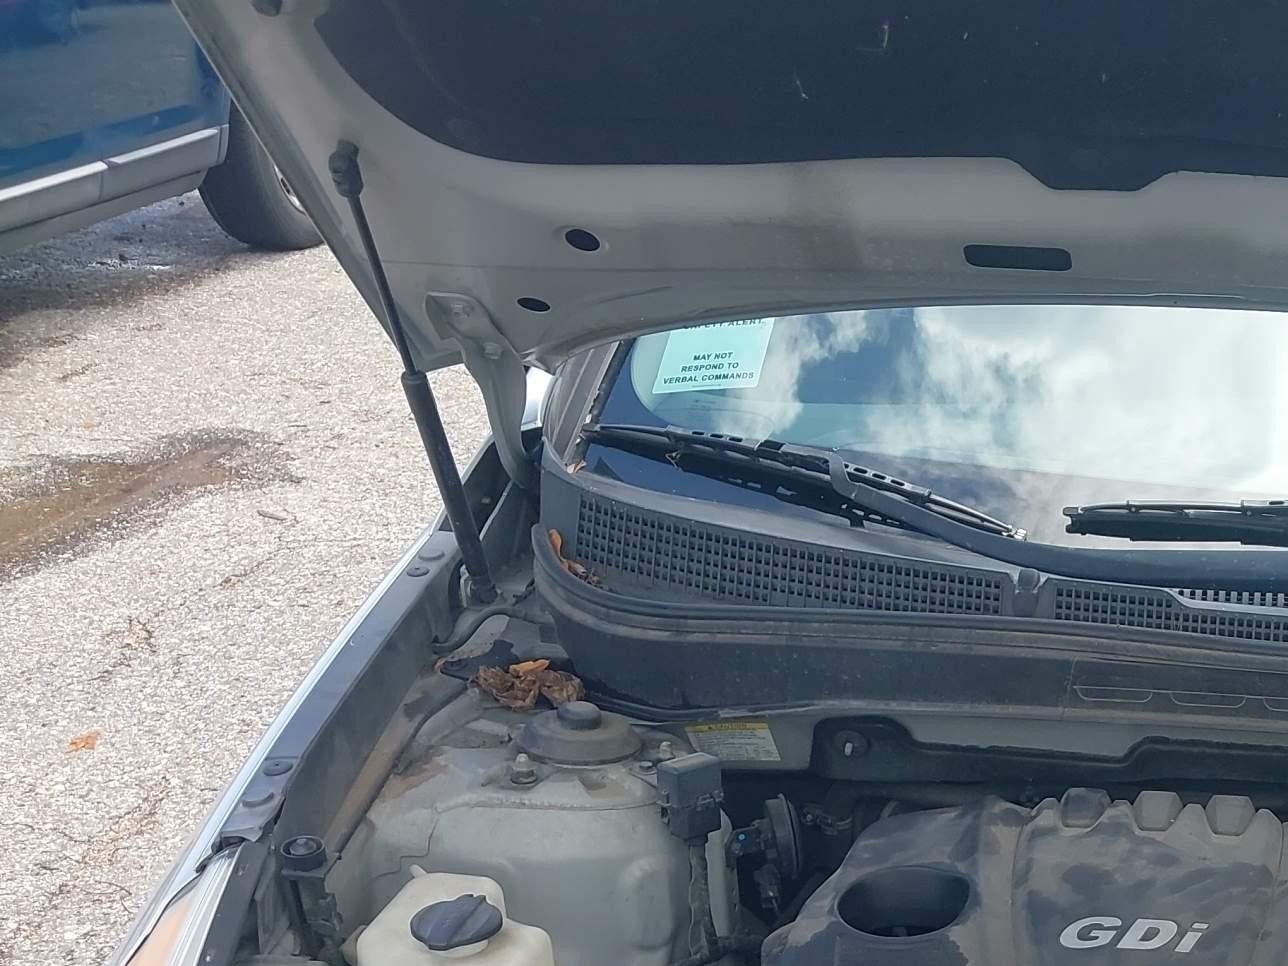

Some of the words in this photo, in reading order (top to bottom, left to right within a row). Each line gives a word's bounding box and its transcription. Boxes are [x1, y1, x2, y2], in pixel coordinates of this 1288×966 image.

[714, 352, 734, 360] NOT
[681, 363, 724, 372] RESPOND
[663, 376, 699, 384] VERBAL
[701, 372, 754, 381] COMMANDS
[1059, 916, 1209, 953] GDi
